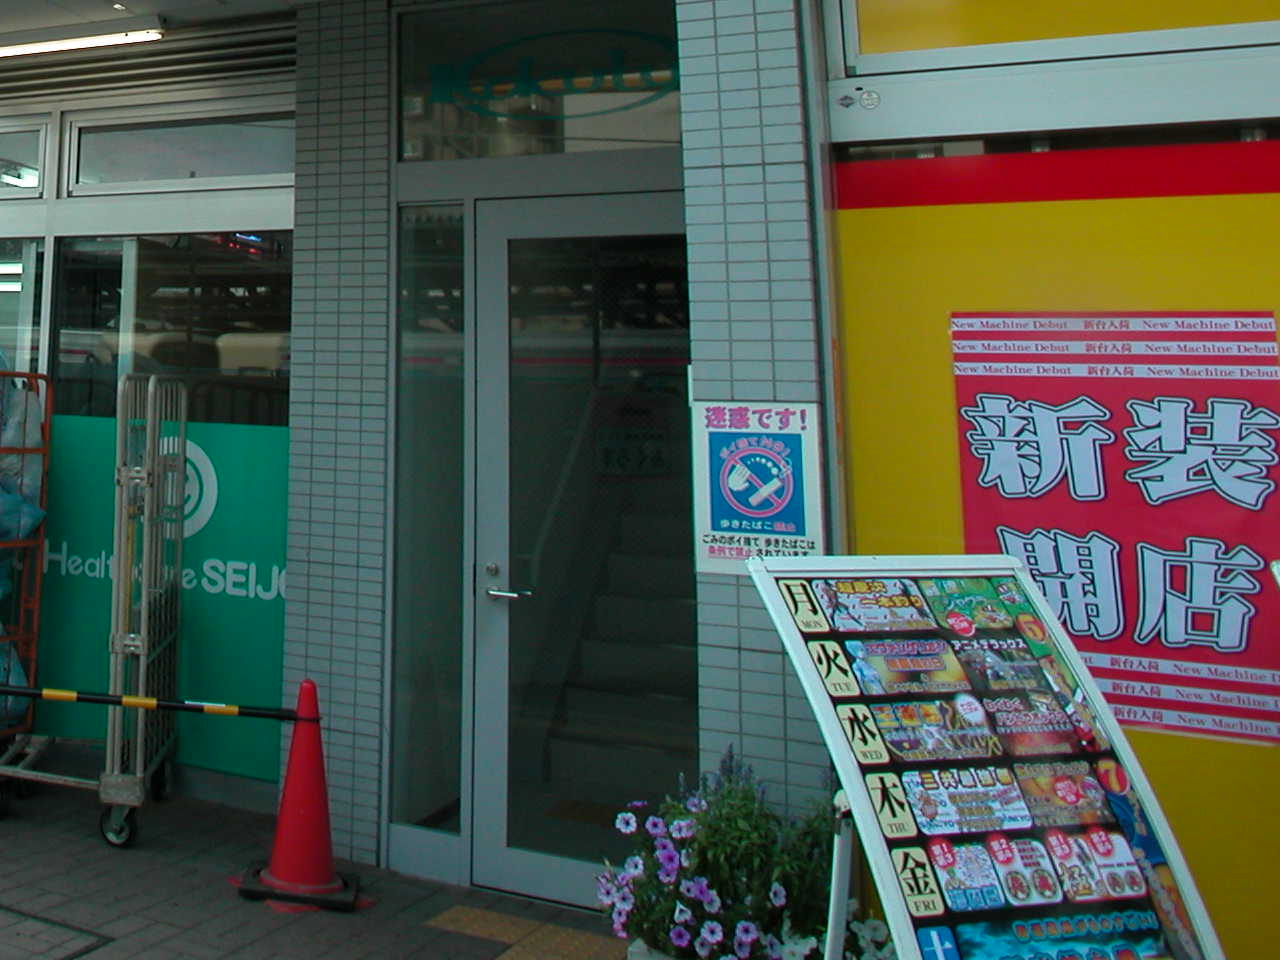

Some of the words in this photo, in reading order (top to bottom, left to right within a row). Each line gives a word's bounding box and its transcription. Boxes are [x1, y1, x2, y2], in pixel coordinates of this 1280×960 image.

[952, 320, 975, 329] New
[979, 320, 1029, 330] Machine
[1033, 320, 1069, 330] Debut
[1142, 320, 1171, 329] New
[1174, 320, 1230, 330] Machine
[1234, 320, 1274, 330] Debut
[953, 343, 977, 352] New
[981, 343, 1032, 353] Machine
[1035, 343, 1070, 353] Debut
[1144, 343, 1172, 353] New
[1176, 343, 1233, 354] Machine
[1237, 344, 1277, 354] Debut
[954, 365, 978, 374] New
[982, 365, 1033, 375] Machine
[1036, 365, 1073, 375] Debut
[1146, 366, 1175, 376] New
[1179, 367, 1236, 377] Machine
[1239, 367, 1280, 378] Debut
[704, 406, 808, 431] 迷惑です!
[960, 393, 1280, 510] 新装
[783, 581, 819, 616] 月
[996, 526, 1268, 655] 開店
[816, 642, 851, 680] 火
[1173, 662, 1201, 676] New
[1206, 667, 1266, 683] Machine
[1175, 688, 1203, 702] New
[1209, 692, 1269, 709] Machine
[842, 706, 879, 748] 水
[1177, 713, 1206, 728] New
[1211, 717, 1271, 735] Machine
[871, 775, 907, 819] 木
[899, 850, 937, 897] 金
[912, 899, 938, 913] FRI
